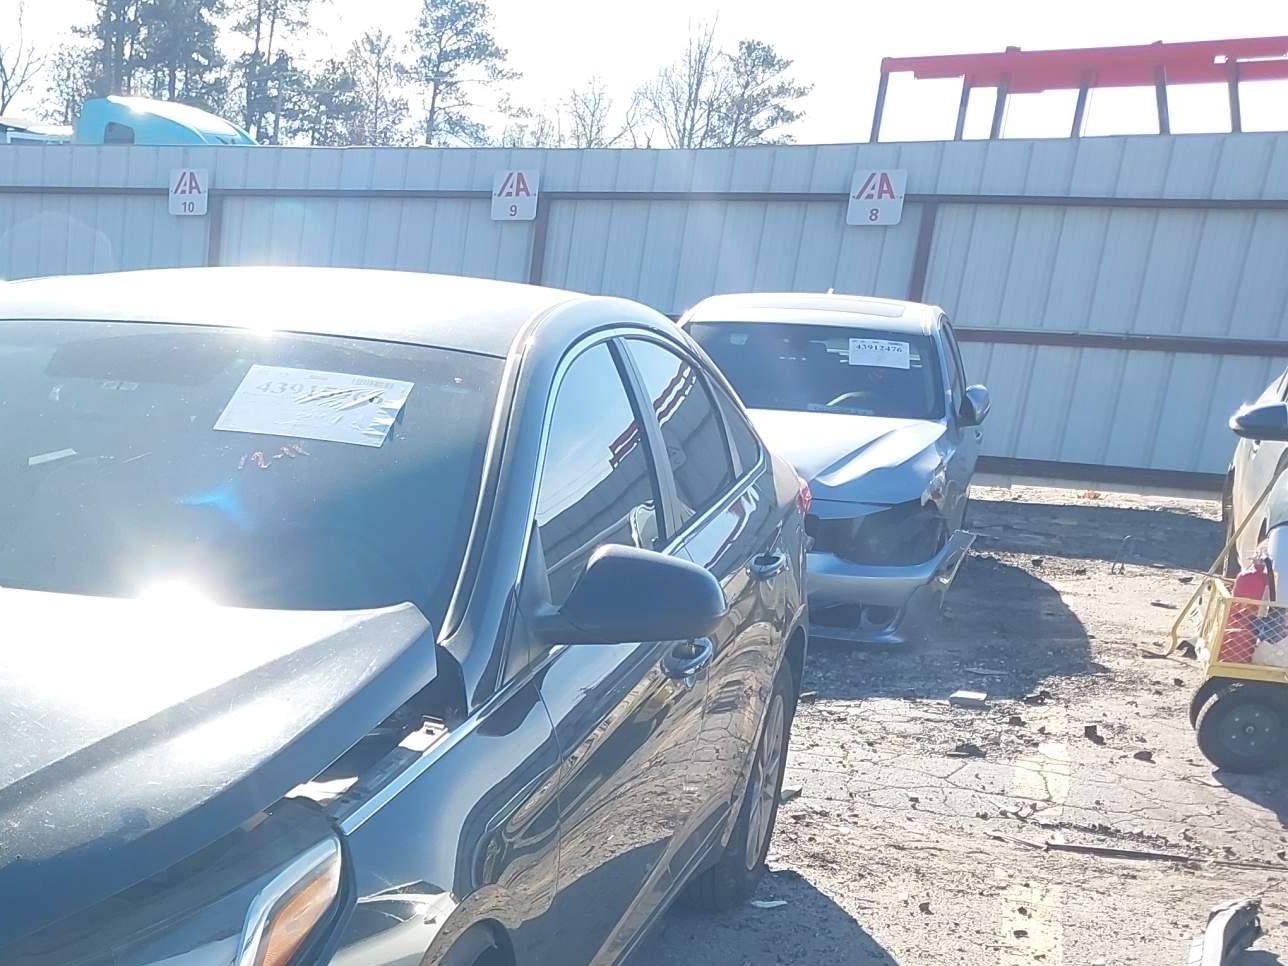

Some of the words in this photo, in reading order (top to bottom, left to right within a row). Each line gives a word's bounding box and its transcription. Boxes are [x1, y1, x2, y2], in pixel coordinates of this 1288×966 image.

[182, 201, 195, 213] 10
[509, 204, 517, 217] 9
[869, 208, 880, 222] 8
